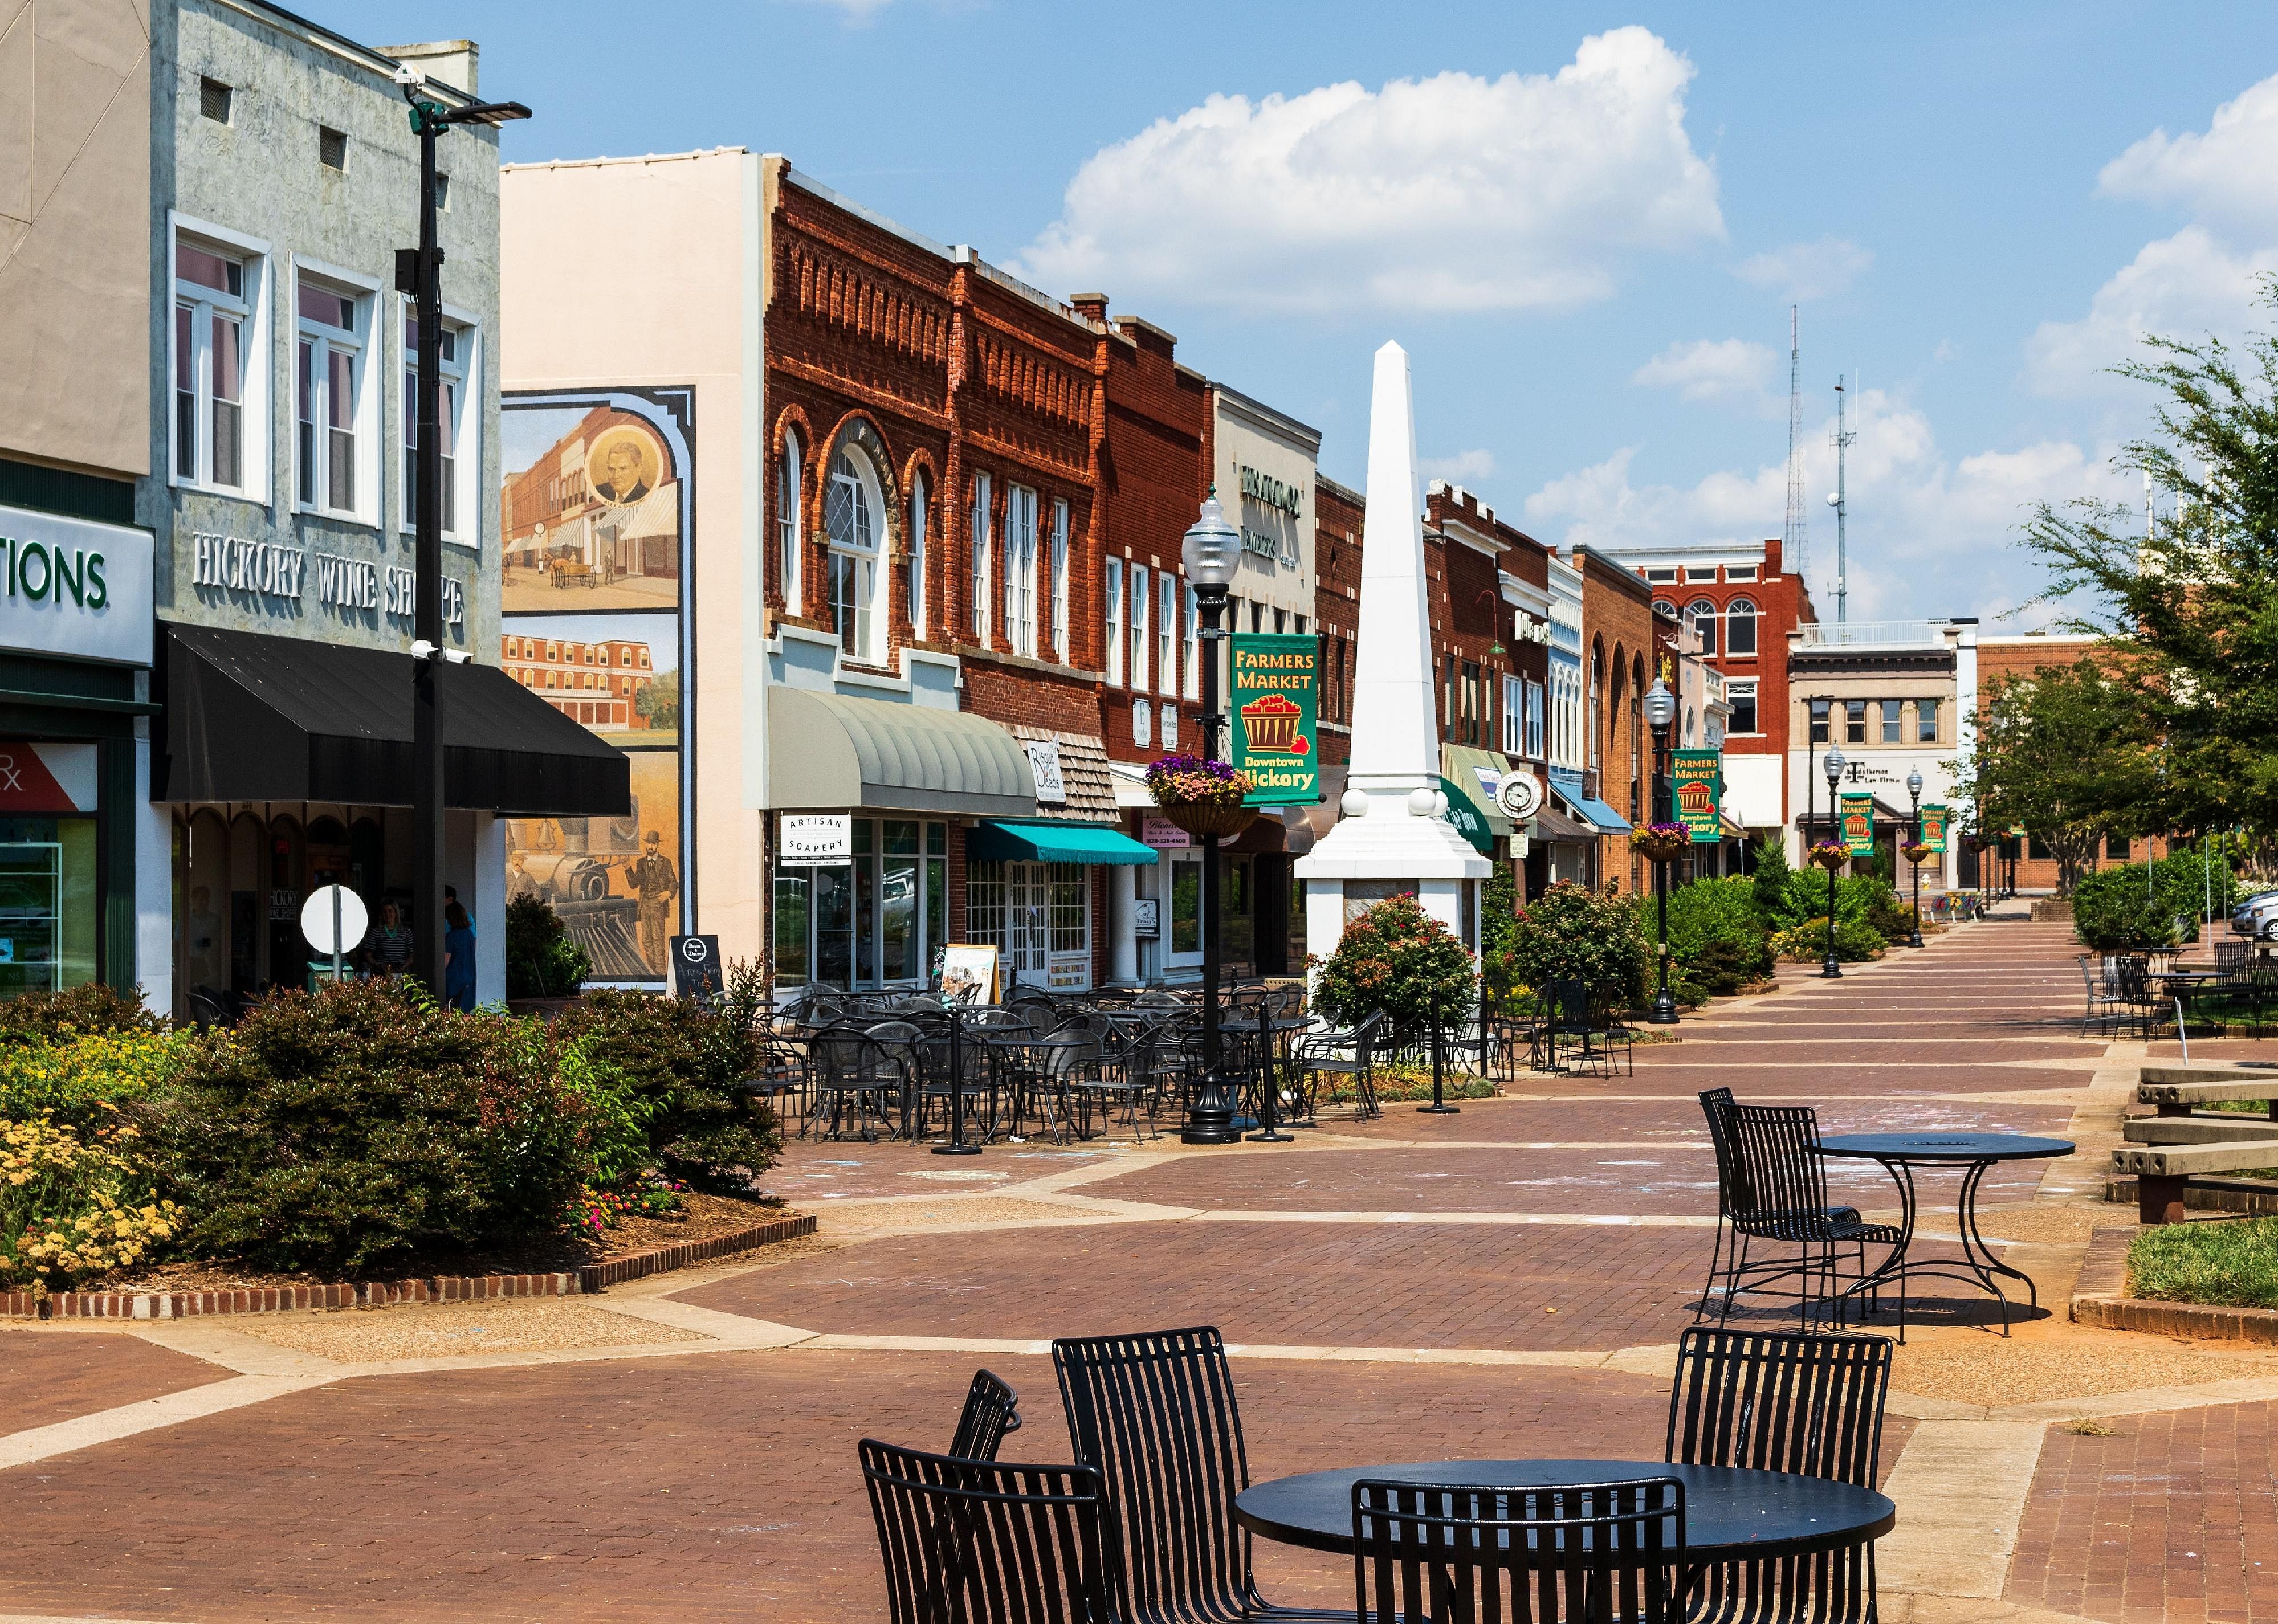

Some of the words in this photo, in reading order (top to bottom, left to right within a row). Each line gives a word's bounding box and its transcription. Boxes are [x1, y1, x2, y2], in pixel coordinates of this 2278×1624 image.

[0, 537, 107, 610] IONS
[192, 531, 304, 598] HICKORY
[315, 552, 376, 609] WINE
[385, 564, 462, 625] SHPE
[1235, 650, 1314, 670] FARMERS
[1237, 671, 1313, 689] MARKET
[1245, 756, 1304, 768] Downtown
[1674, 758, 1717, 768] FARMERS
[1676, 770, 1717, 779] MARKET
[790, 817, 842, 829] ARTISAN
[1685, 821, 1718, 834] ckory
[788, 839, 842, 852] SOAPERY
[1851, 842, 1873, 851] ckory
[270, 889, 298, 906] HICKORY
